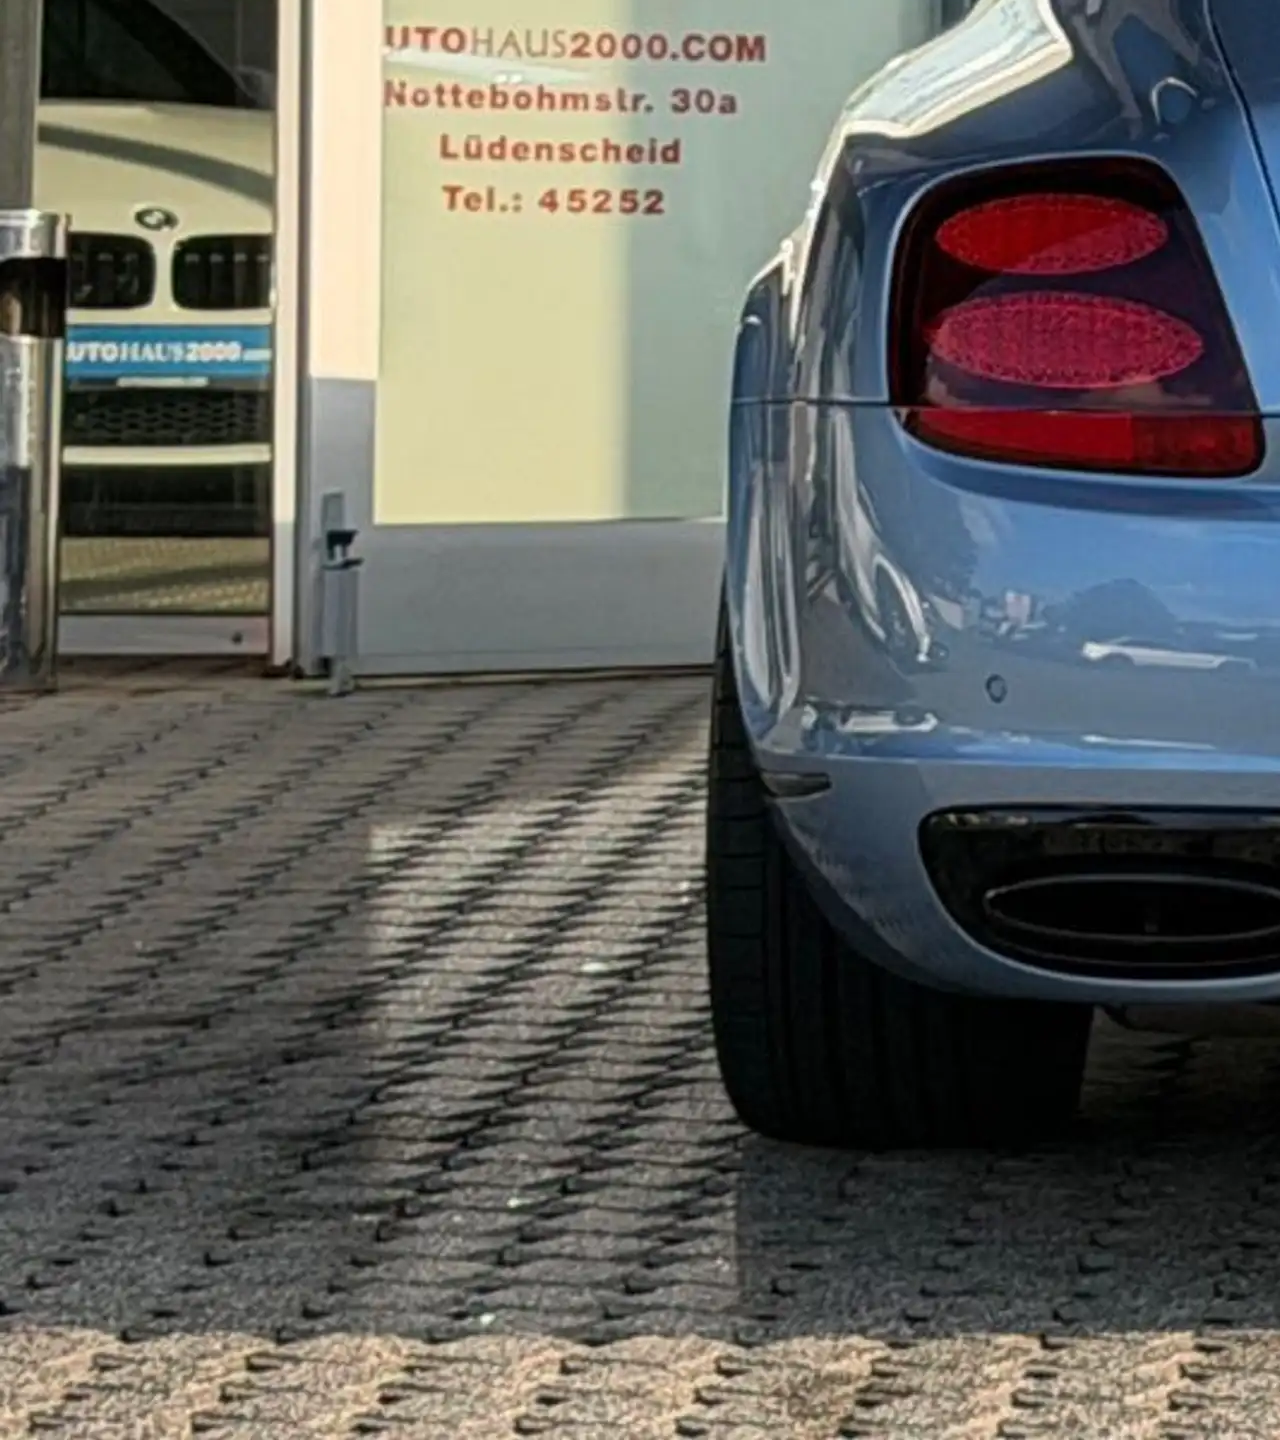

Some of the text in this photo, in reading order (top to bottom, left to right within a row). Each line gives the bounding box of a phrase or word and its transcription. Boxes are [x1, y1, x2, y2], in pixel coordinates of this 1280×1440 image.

[384, 80, 738, 114] Nottebohmstr. 30a
[439, 133, 681, 164] Lüdenscheid
[441, 185, 666, 215] Tel.: 45252
